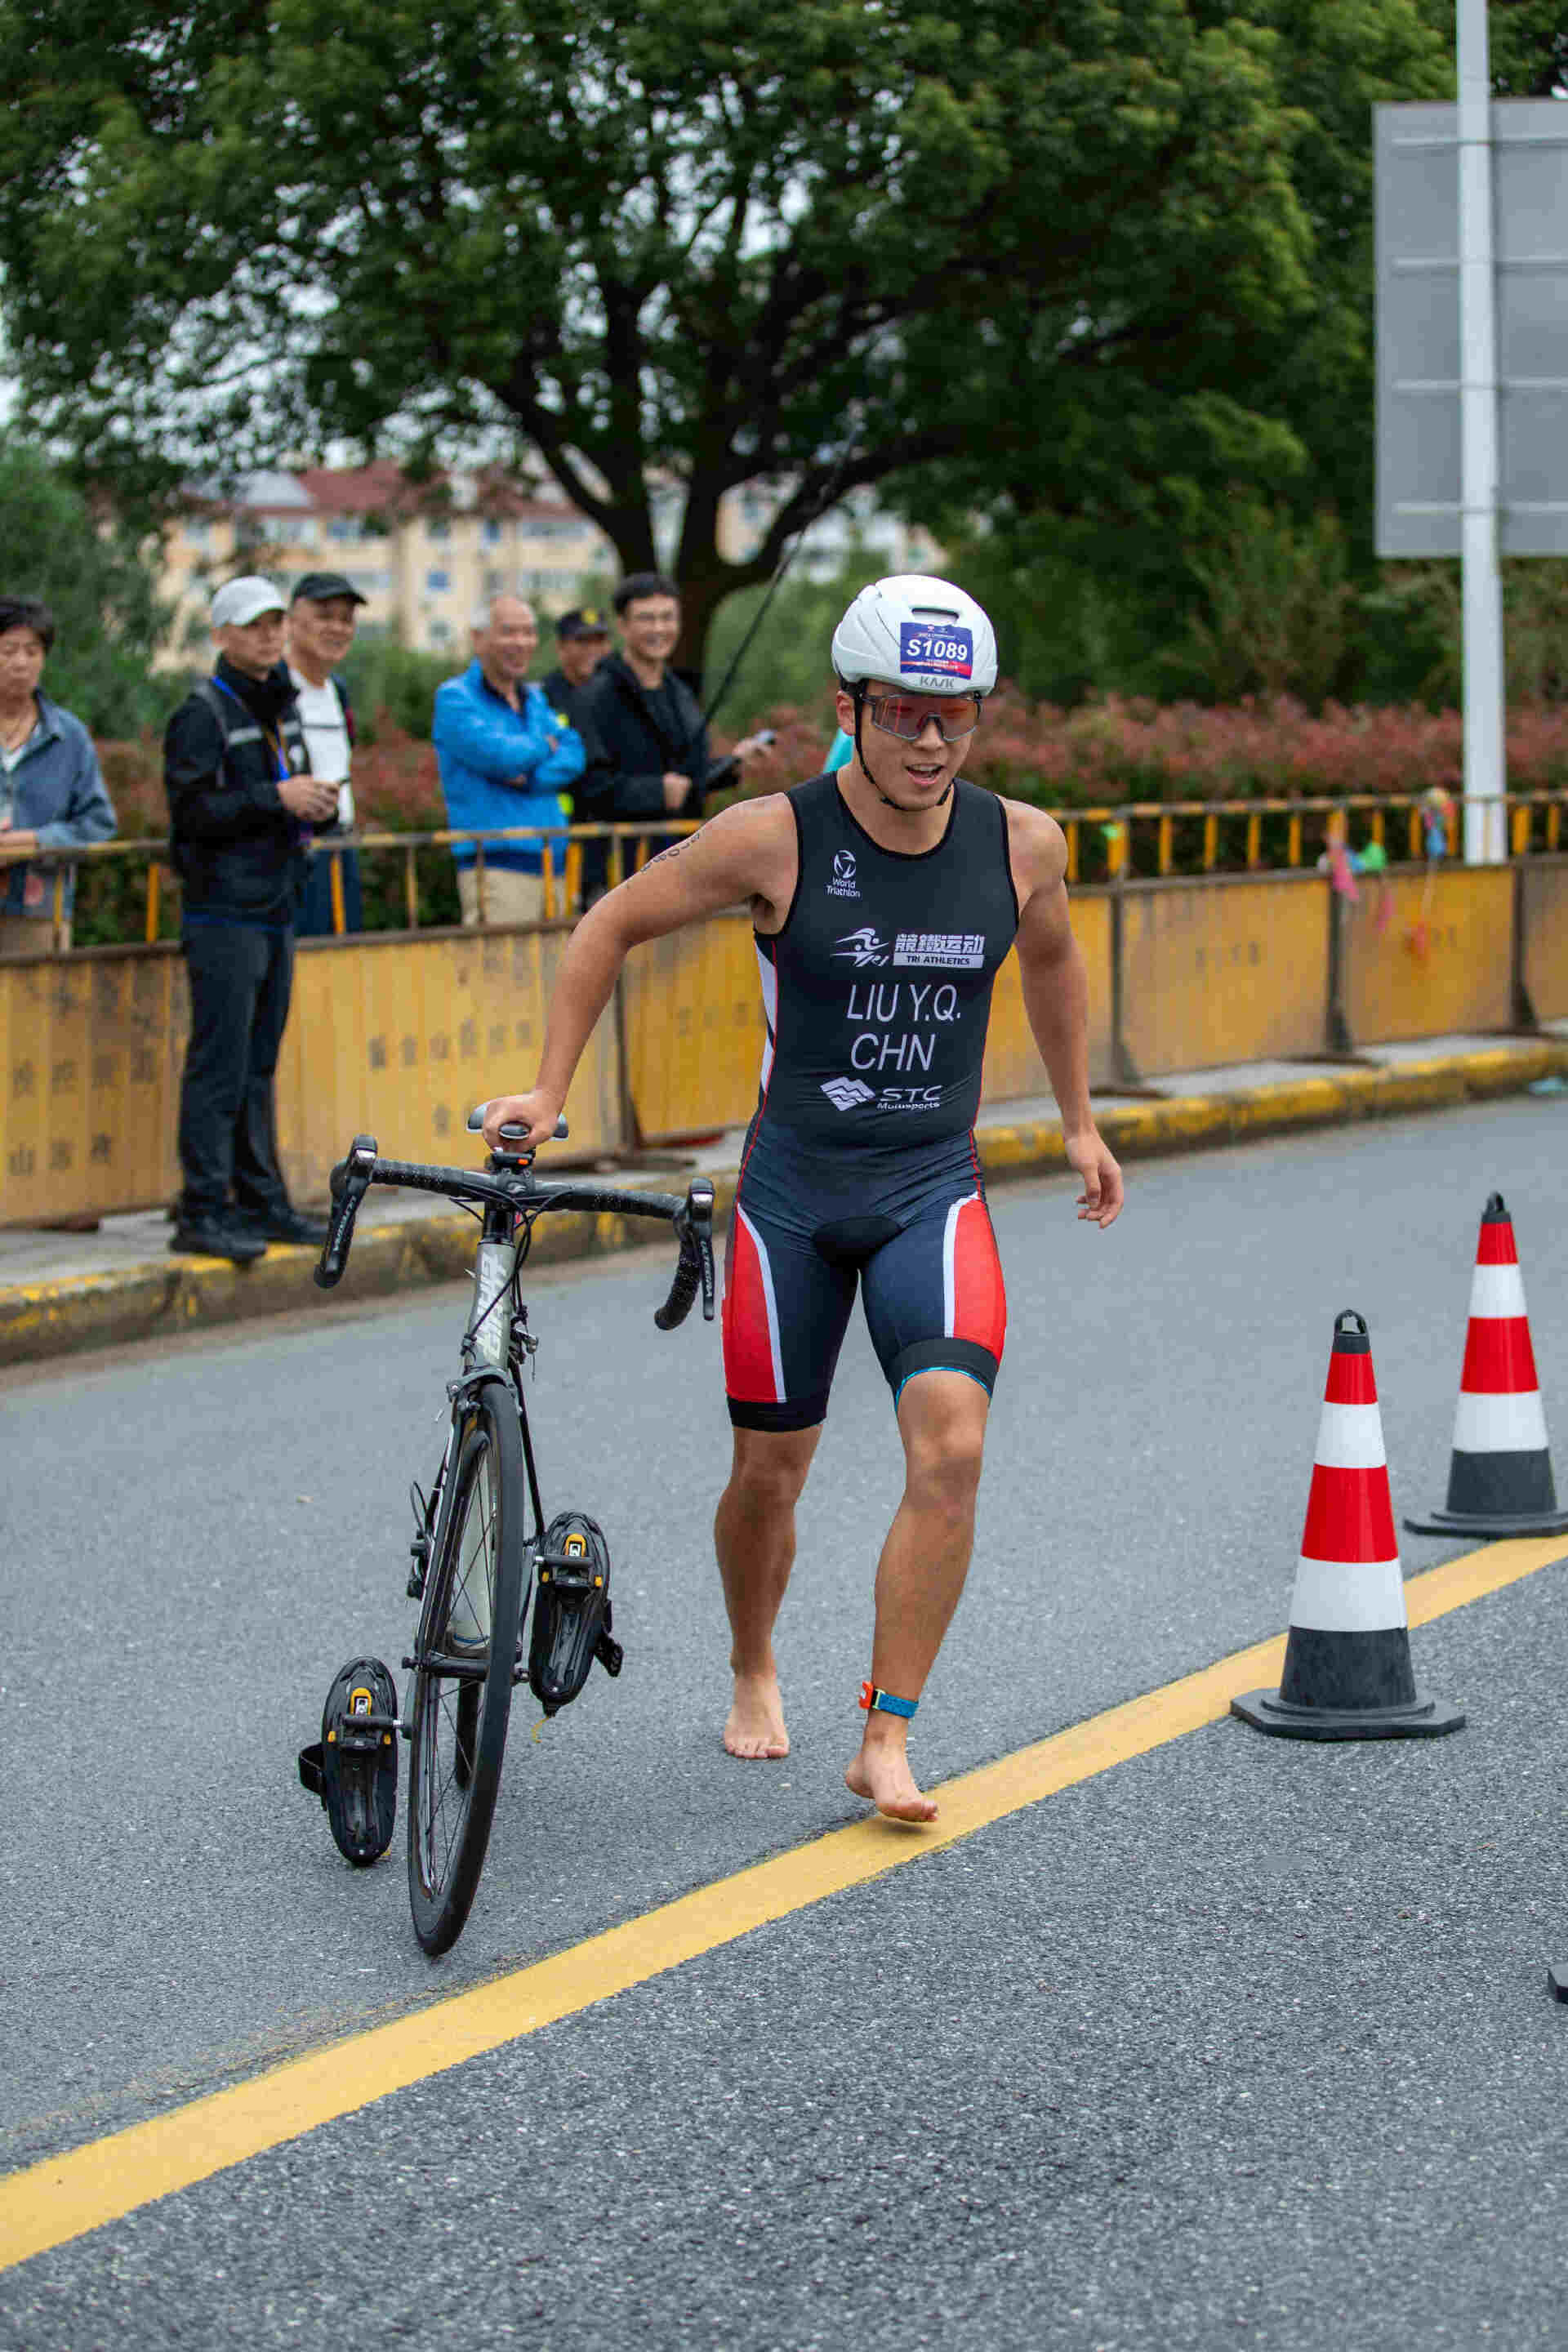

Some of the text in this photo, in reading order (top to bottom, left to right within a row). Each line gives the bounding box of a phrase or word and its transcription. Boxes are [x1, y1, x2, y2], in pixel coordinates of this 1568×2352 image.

[906, 639, 968, 661] S1089
[832, 876, 856, 889] World
[826, 885, 861, 898] Triathlon
[923, 956, 971, 965] ATHLETICS
[847, 983, 961, 1022] LIU Y.Q.
[850, 1032, 936, 1071] CHN
[880, 1085, 943, 1102] STC
